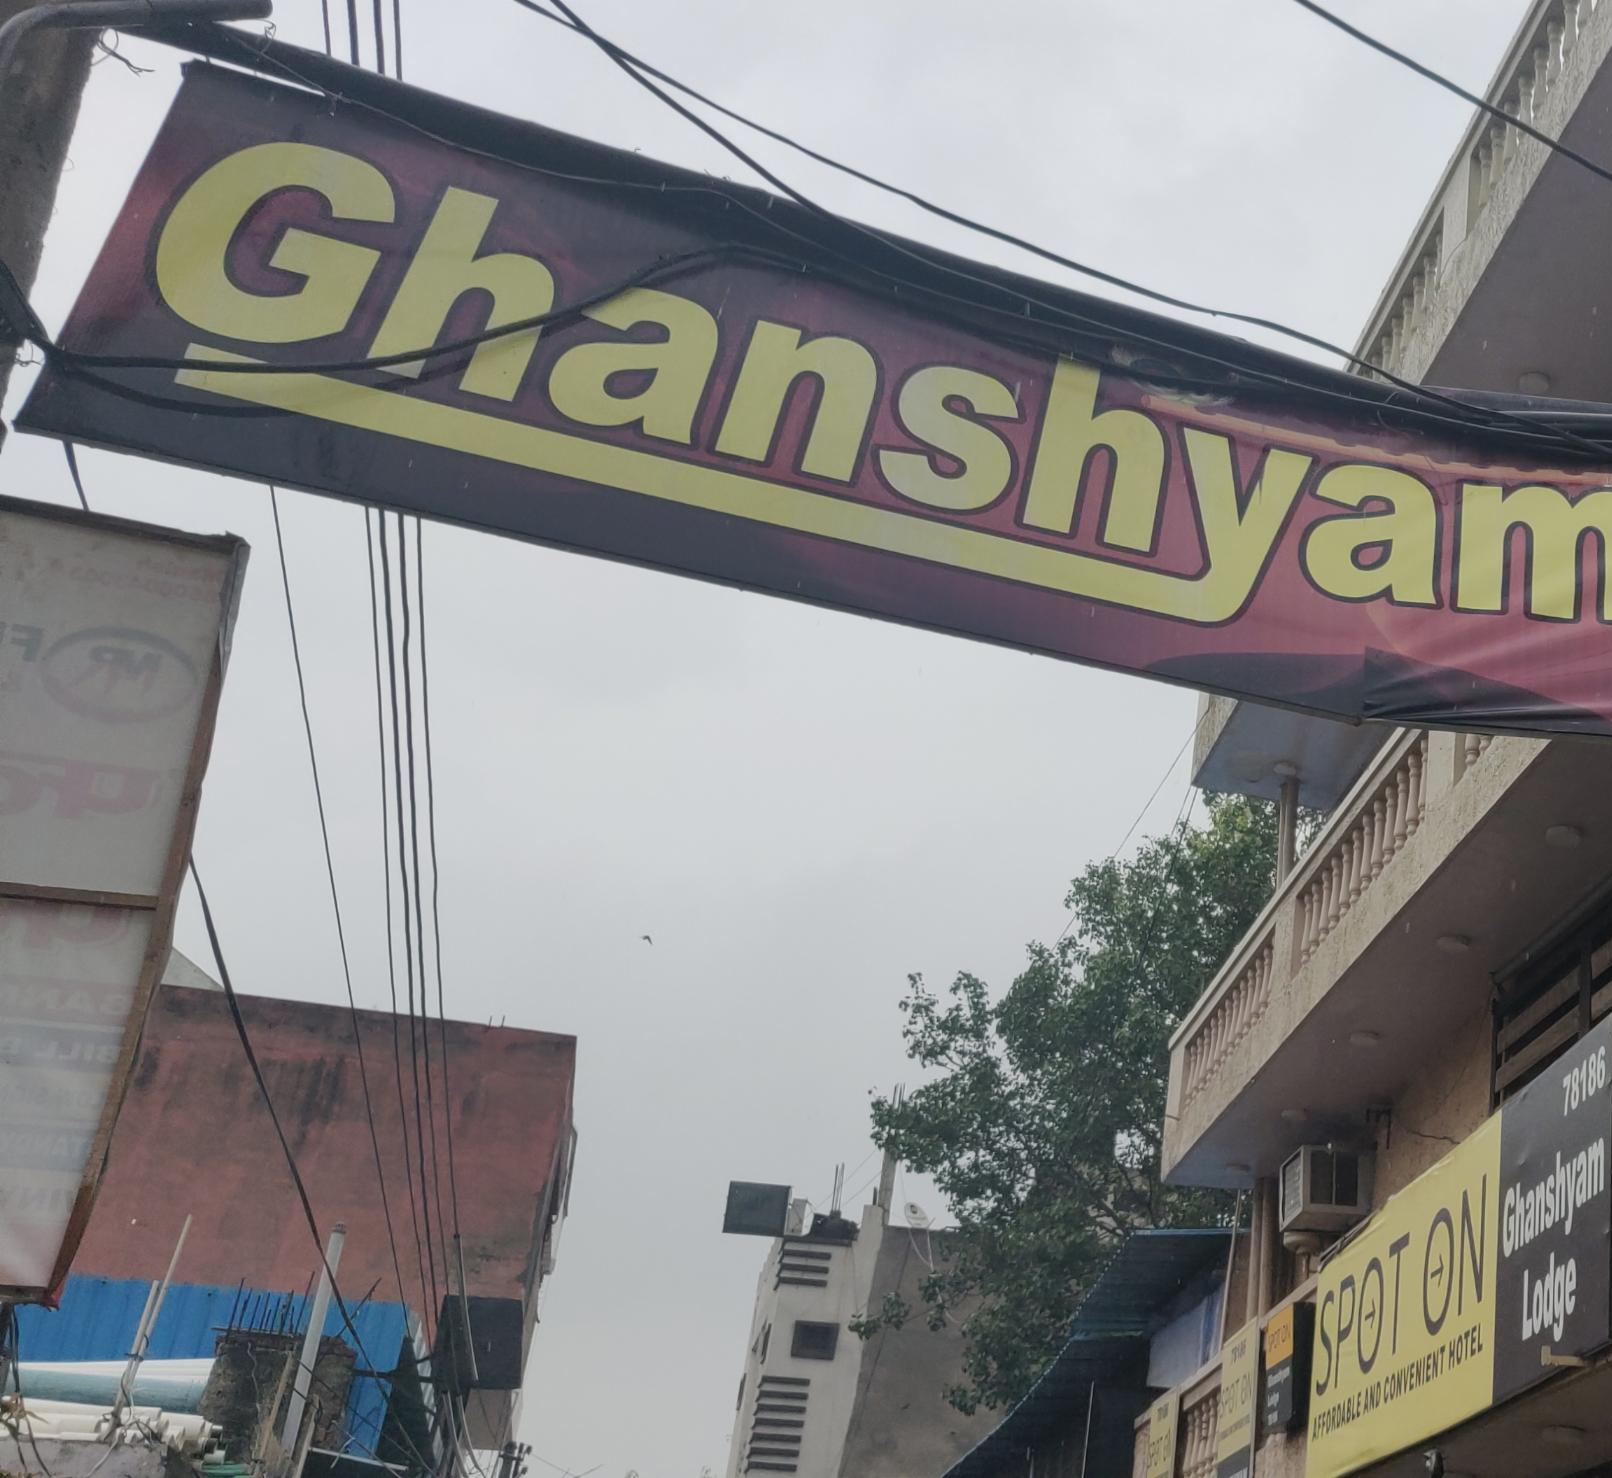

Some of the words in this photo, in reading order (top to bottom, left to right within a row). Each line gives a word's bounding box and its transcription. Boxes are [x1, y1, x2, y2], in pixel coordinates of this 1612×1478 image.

[1562, 1045, 1607, 1117] 78186
[1502, 1135, 1606, 1259] Ghanshyam
[1315, 1231, 1411, 1397] SPOT
[1422, 1172, 1488, 1337] ON
[1521, 1256, 1578, 1343] Lodge
[1312, 1391, 1362, 1443] AFFORDABLE
[1363, 1380, 1382, 1415] AND
[1383, 1344, 1446, 1405] CONVENIENT
[1448, 1322, 1484, 1372] HOTEL
